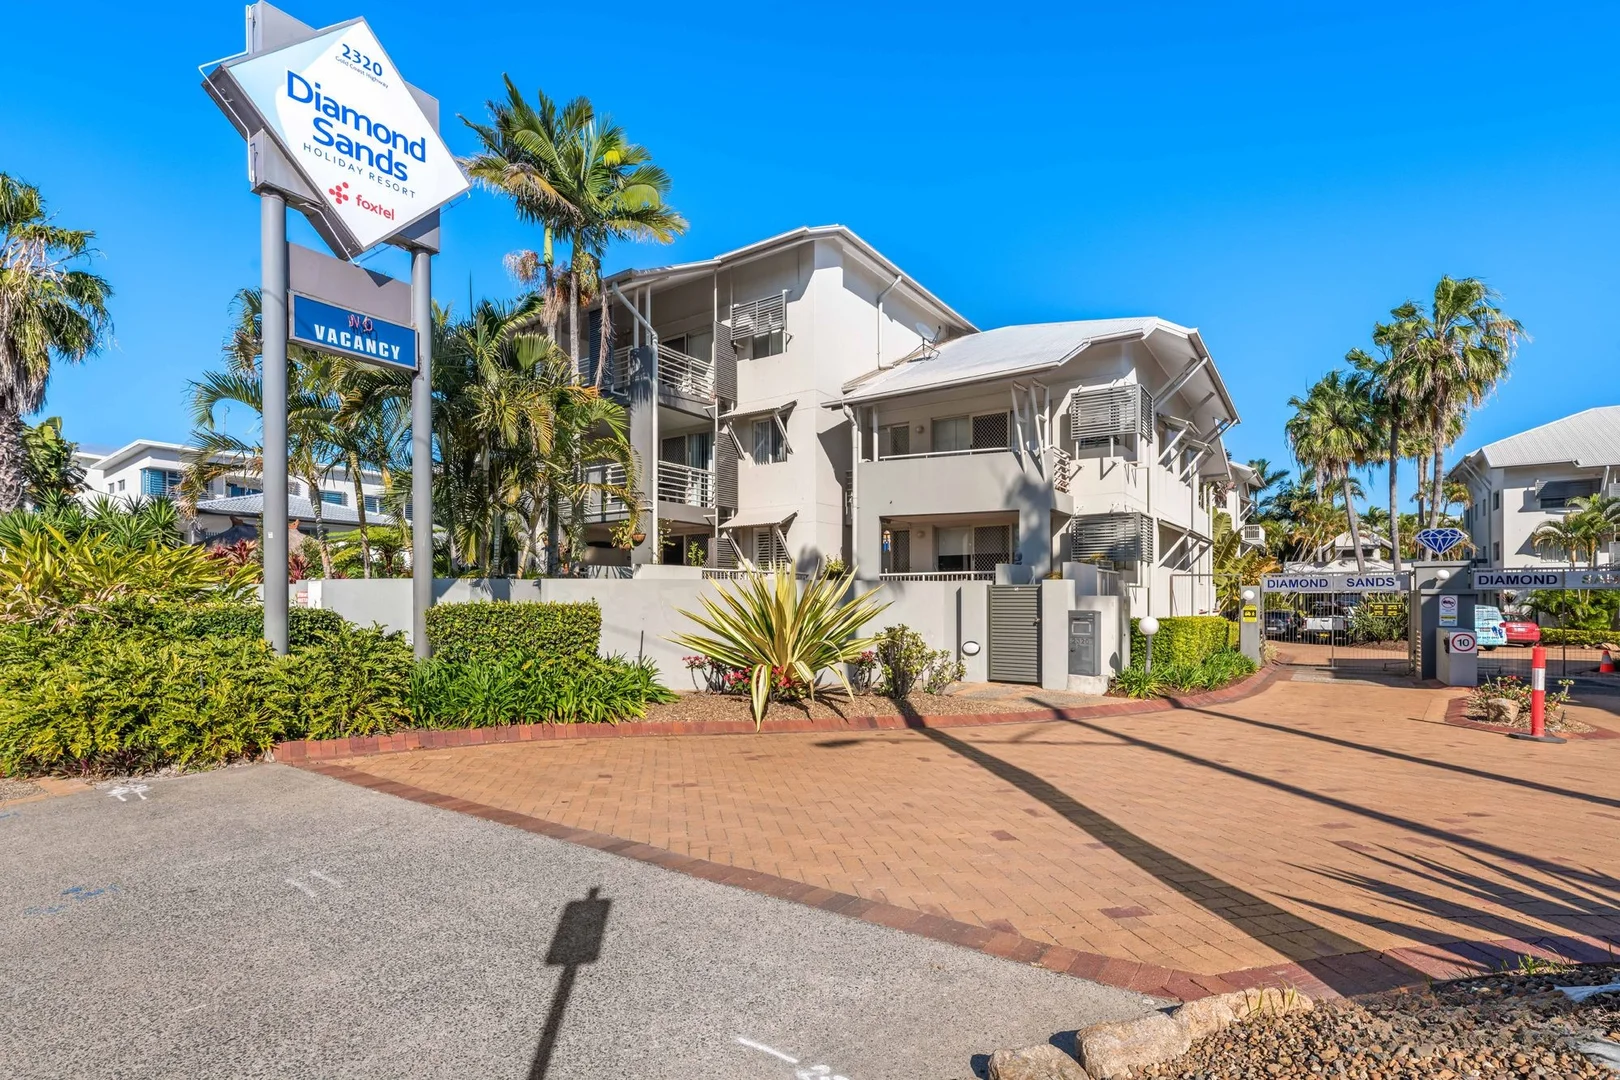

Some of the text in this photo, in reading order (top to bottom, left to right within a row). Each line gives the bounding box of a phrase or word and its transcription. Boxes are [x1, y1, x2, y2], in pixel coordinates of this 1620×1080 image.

[335, 55, 349, 67] Gold
[349, 63, 365, 76] Coast
[342, 43, 383, 77] 2320
[287, 69, 426, 164] Diamond
[313, 117, 408, 182] Sands
[303, 142, 416, 198] HOLIDAY RESORT
[355, 194, 395, 221] foxtel
[348, 314, 373, 332] NO
[314, 324, 401, 361] VACANCY
[1267, 577, 1395, 588] DIAMOND SANDS
[1478, 574, 1558, 585] DIAMOND
[1457, 638, 1470, 647] 10
